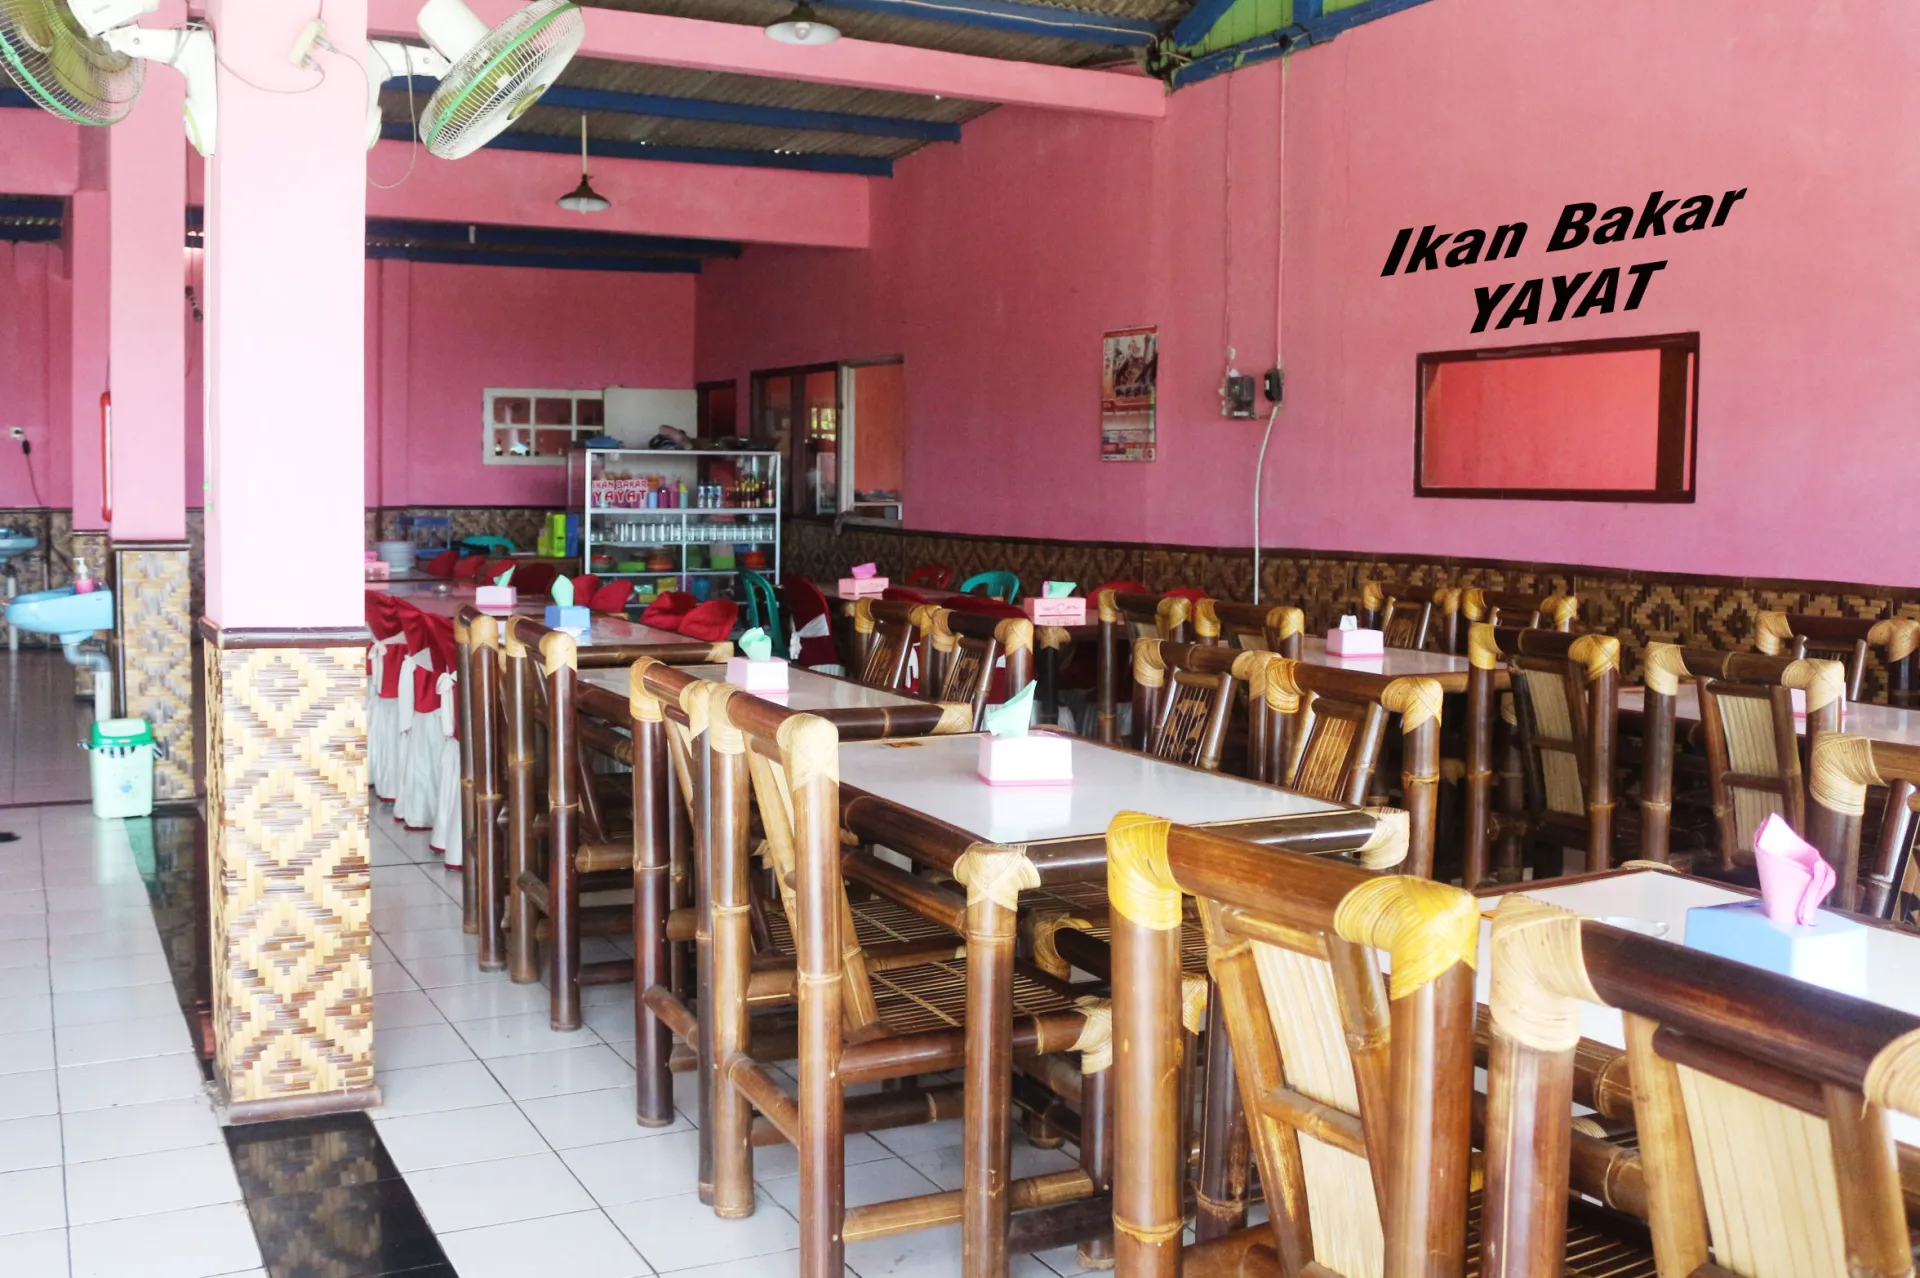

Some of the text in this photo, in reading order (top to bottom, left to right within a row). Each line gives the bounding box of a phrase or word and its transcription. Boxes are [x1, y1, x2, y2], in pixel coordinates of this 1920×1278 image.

[1380, 187, 1748, 277] Ikan Bakar
[1469, 260, 1668, 334] YAYAT
[592, 479, 648, 489] IKAN BAKAR
[594, 489, 647, 502] YAYAT
